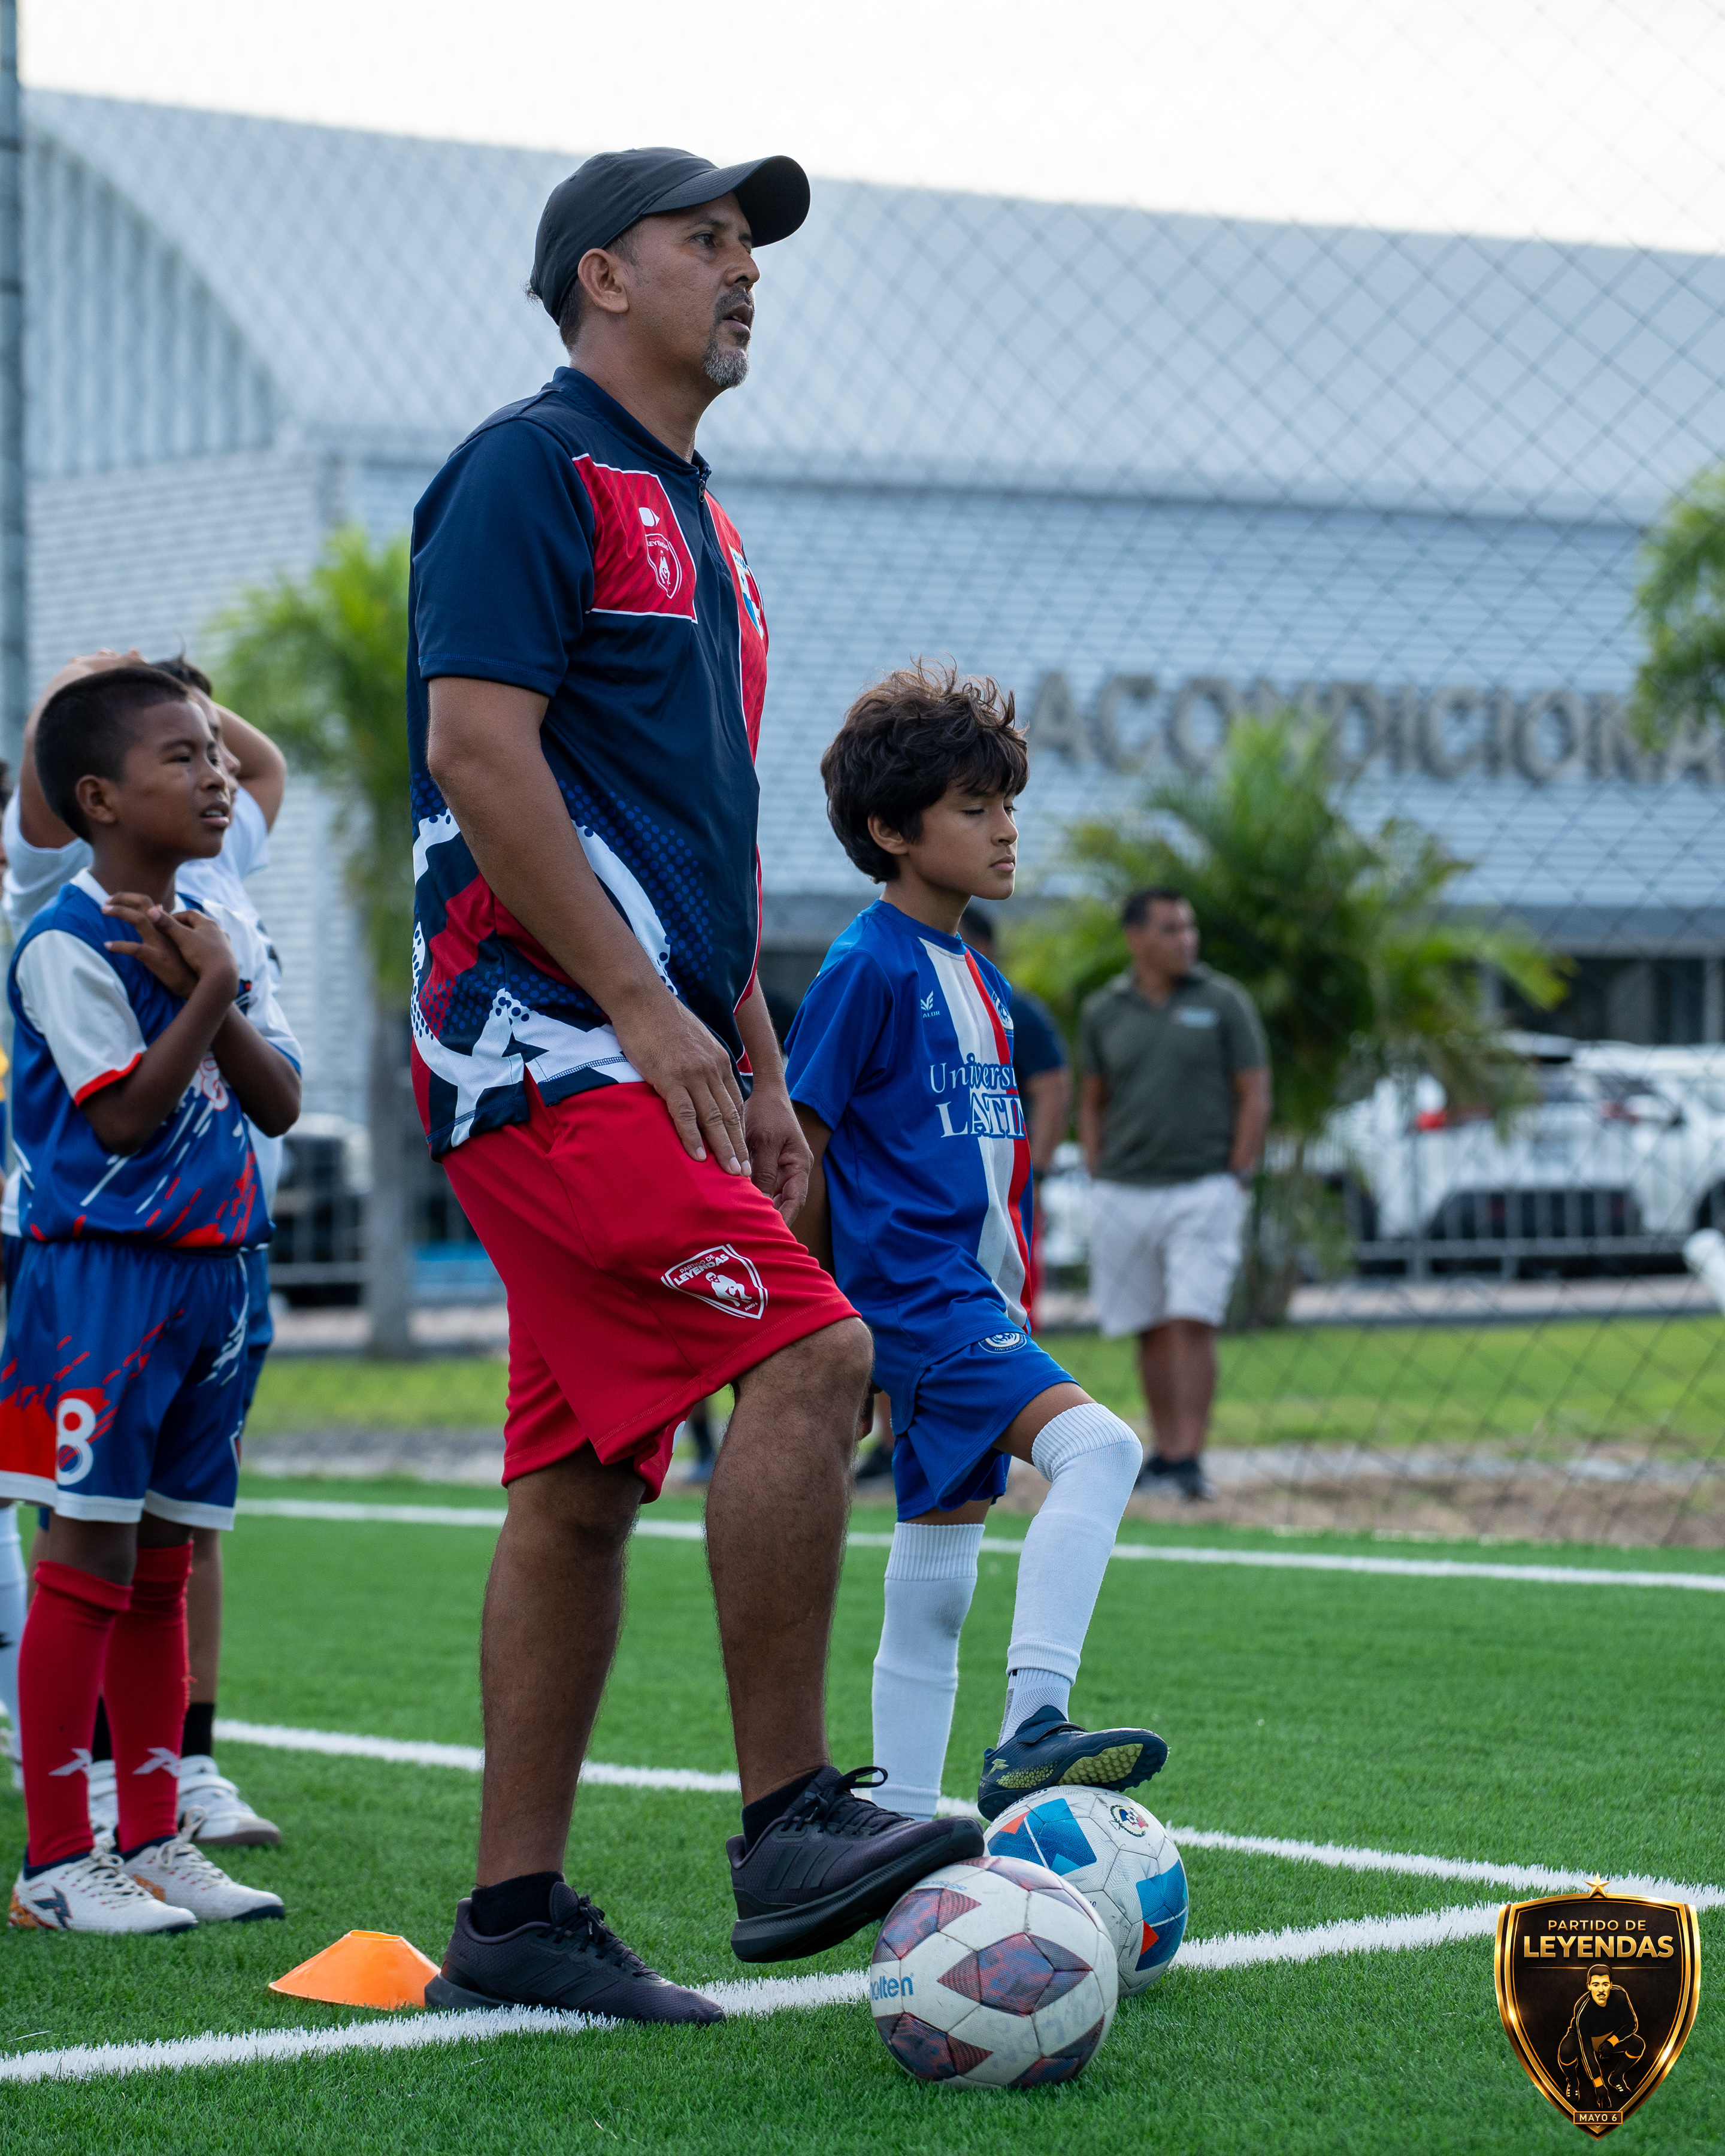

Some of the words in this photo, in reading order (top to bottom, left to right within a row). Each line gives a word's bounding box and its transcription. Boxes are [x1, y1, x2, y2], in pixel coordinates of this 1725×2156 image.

[673, 1253, 730, 1286] LEYENDAS
[679, 1259, 706, 1274] PARTIDO
[56, 1397, 96, 1486] 8
[870, 1975, 913, 2001] olten
